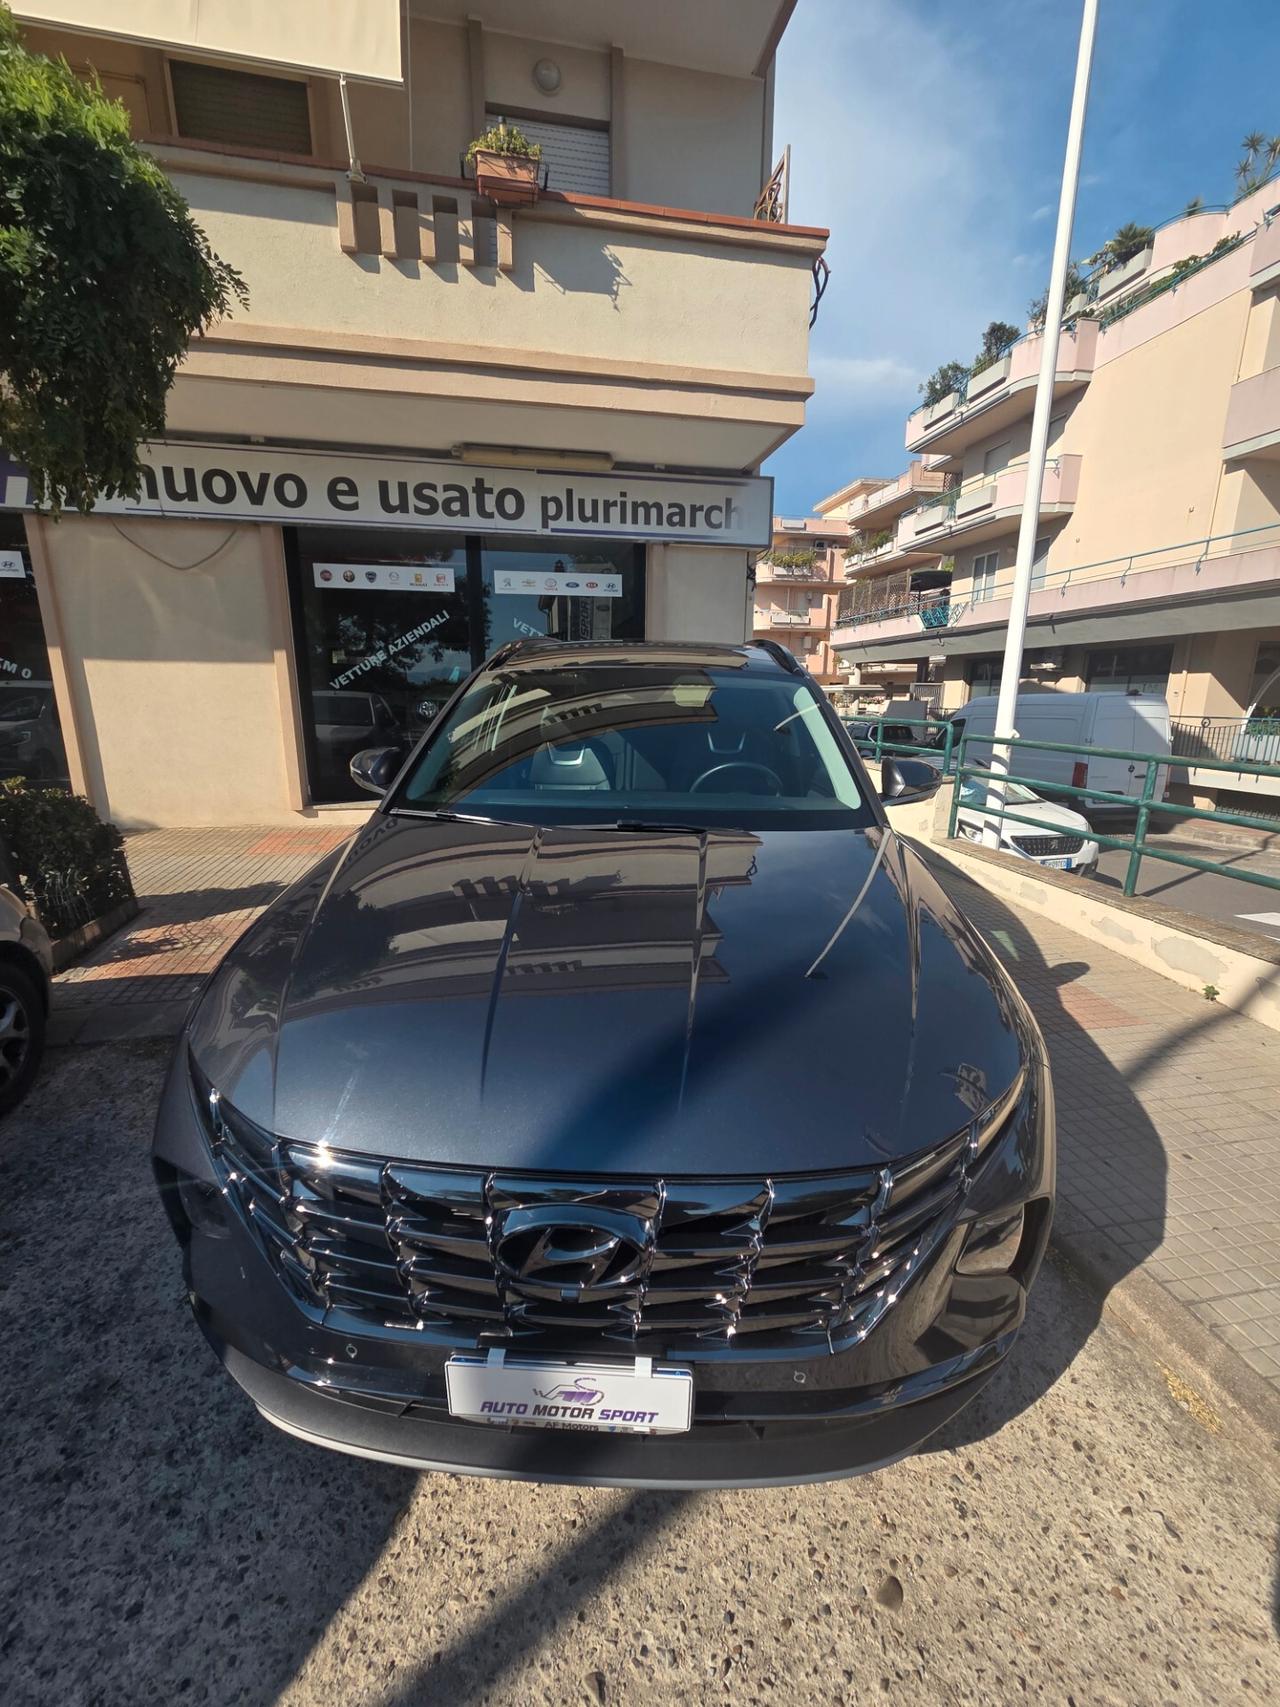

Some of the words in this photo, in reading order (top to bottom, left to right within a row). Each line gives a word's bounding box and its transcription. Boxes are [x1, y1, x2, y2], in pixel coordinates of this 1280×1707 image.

[327, 475, 359, 512] e
[379, 477, 526, 521] usato
[0, 657, 18, 674] M
[329, 649, 388, 690] VETTURE
[388, 609, 450, 655] AZIENDALI
[480, 1401, 528, 1415] AUTO
[532, 1405, 594, 1419] MOTOR
[598, 1409, 658, 1423] SPORT
